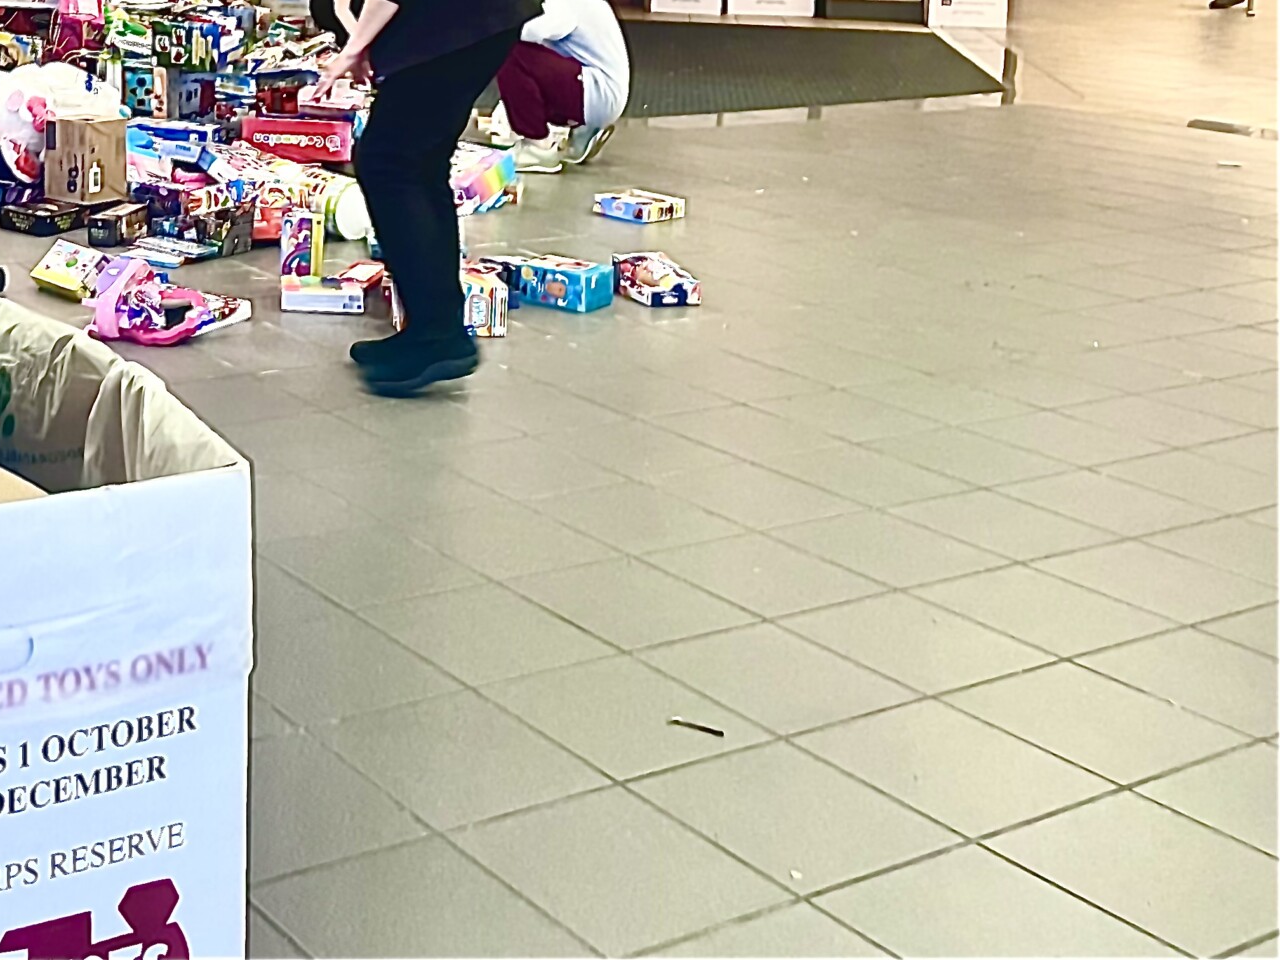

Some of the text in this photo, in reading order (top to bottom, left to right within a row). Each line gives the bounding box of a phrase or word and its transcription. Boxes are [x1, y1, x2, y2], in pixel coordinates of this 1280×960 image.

[37, 659, 121, 704] TOYS
[130, 641, 213, 682] ONLY
[19, 740, 30, 770] 1
[40, 705, 198, 764] OCTOBER
[49, 822, 186, 880] RESERVE
